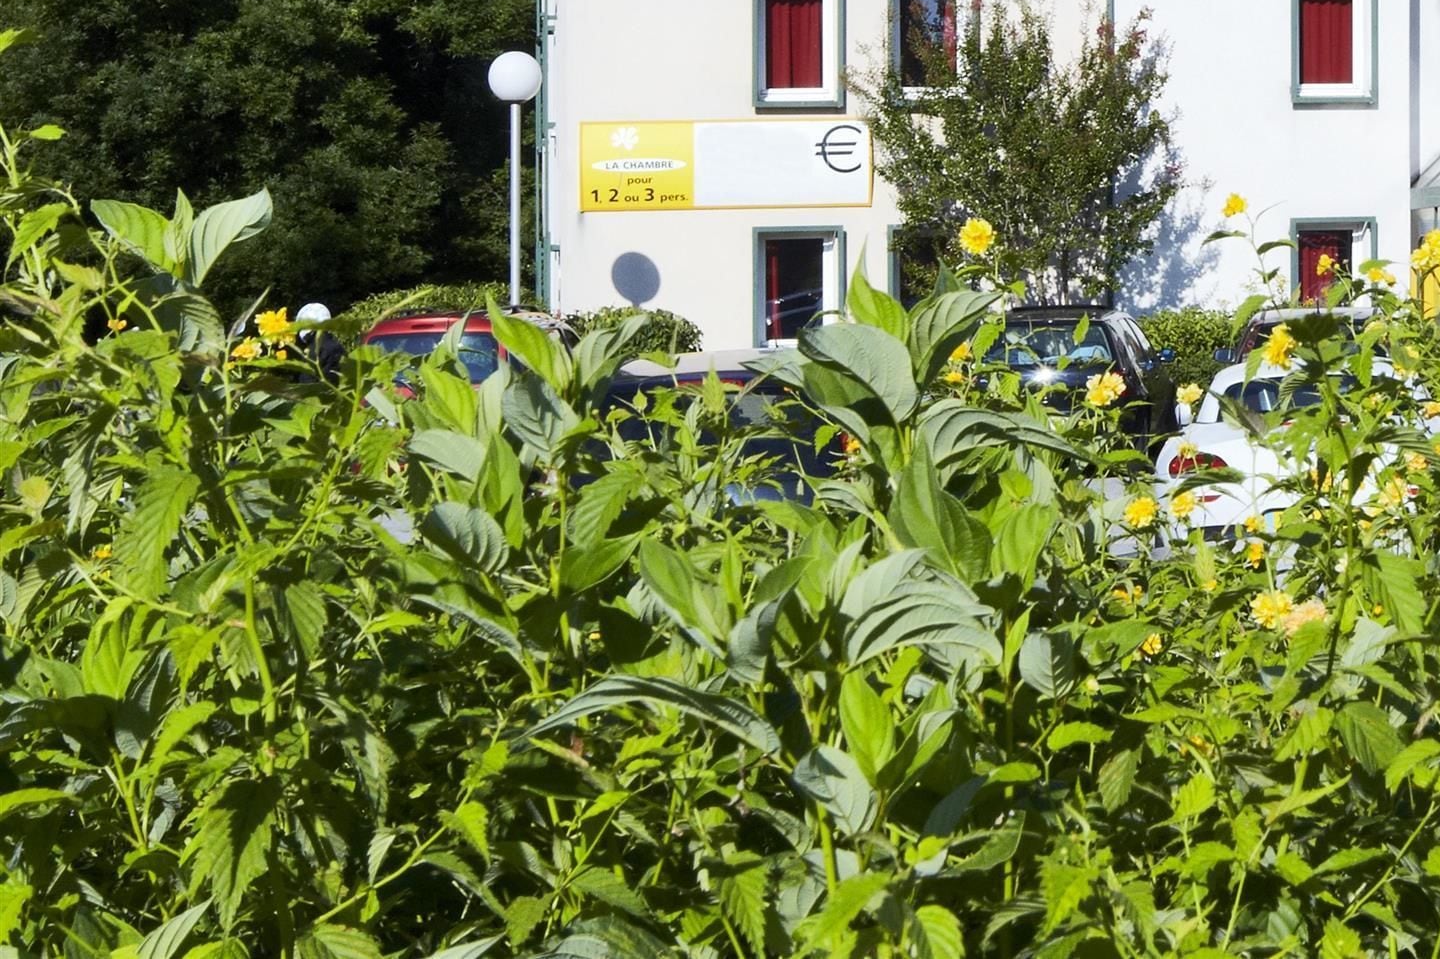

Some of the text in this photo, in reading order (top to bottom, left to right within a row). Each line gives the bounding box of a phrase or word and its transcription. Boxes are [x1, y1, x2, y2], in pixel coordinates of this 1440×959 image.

[815, 124, 862, 173] €
[605, 160, 674, 170] LA CHAMBRE
[627, 176, 653, 187] pour
[608, 188, 619, 203] 2
[624, 194, 640, 203] ou
[644, 187, 655, 202] 3
[660, 193, 689, 204] pers.
